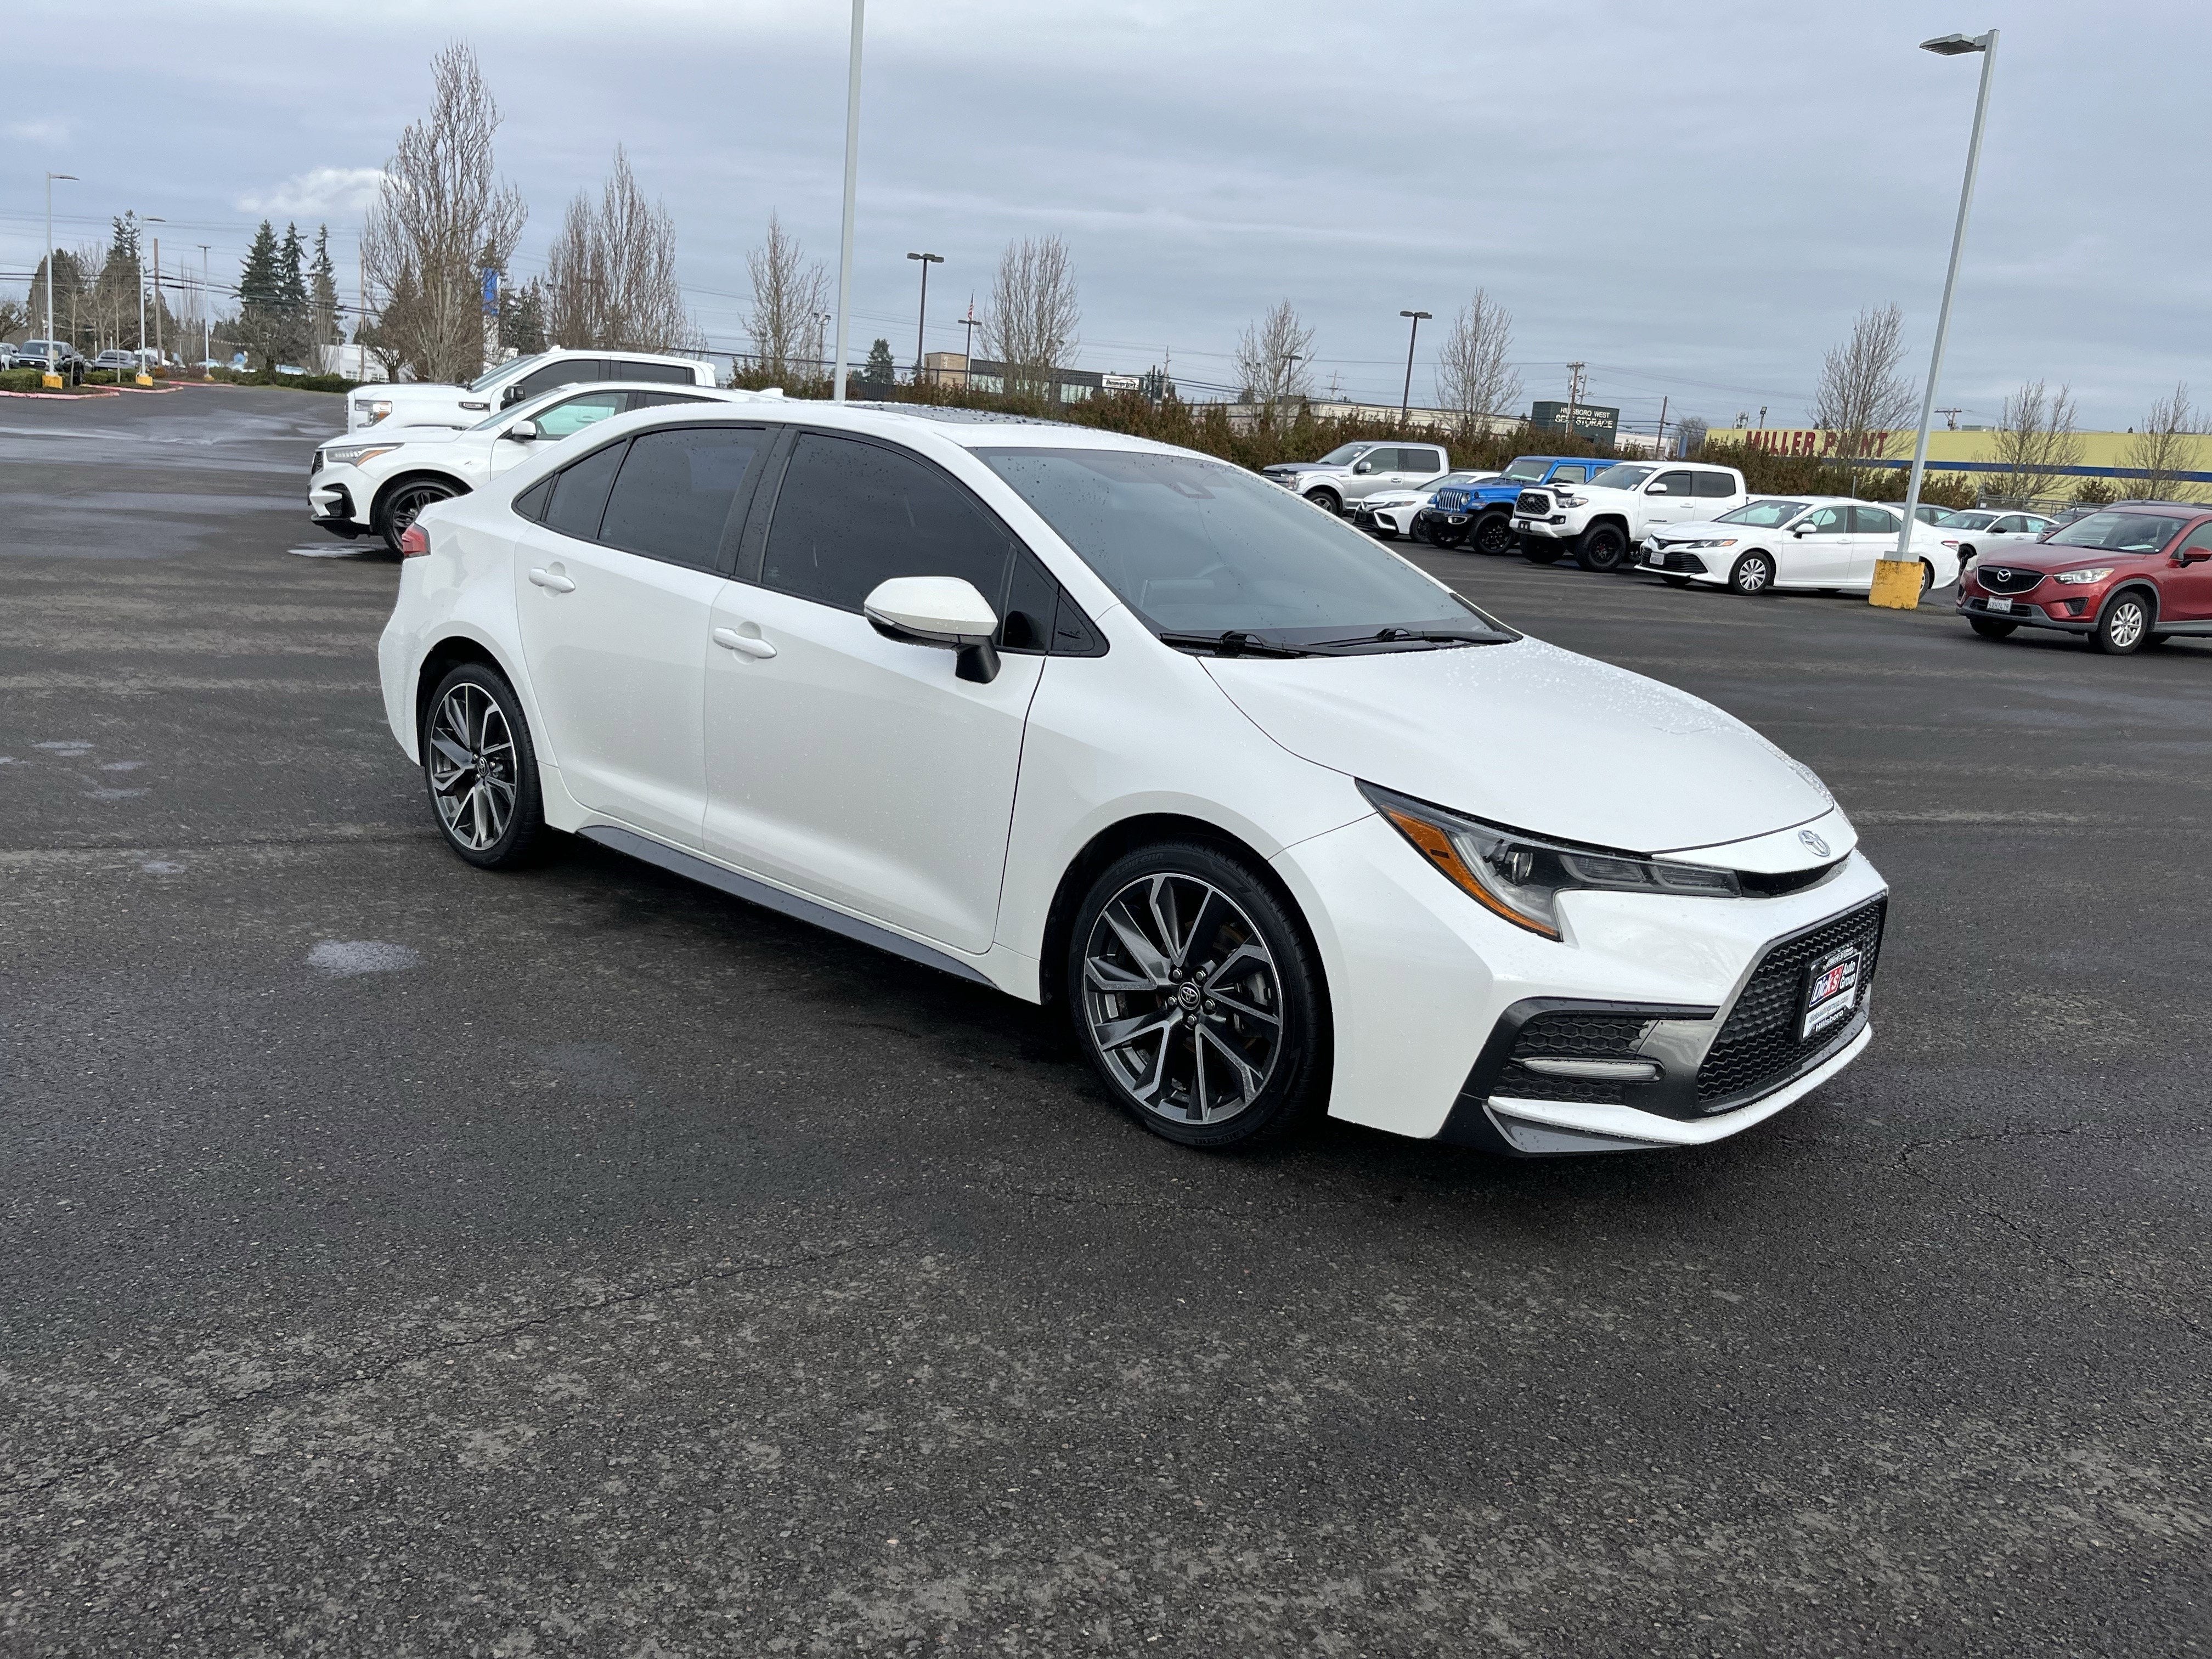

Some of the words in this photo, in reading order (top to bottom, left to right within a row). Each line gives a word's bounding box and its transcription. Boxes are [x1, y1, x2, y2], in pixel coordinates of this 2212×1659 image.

[1576, 416, 1613, 428] STORAGE
[1745, 431, 1815, 456] MILLER
[1821, 432, 1888, 458] PANT
[1842, 961, 1855, 976] Auto
[1812, 972, 1839, 1002] Dick's
[1839, 973, 1856, 990] Group
[1815, 1010, 1843, 1031] Hillsboro
